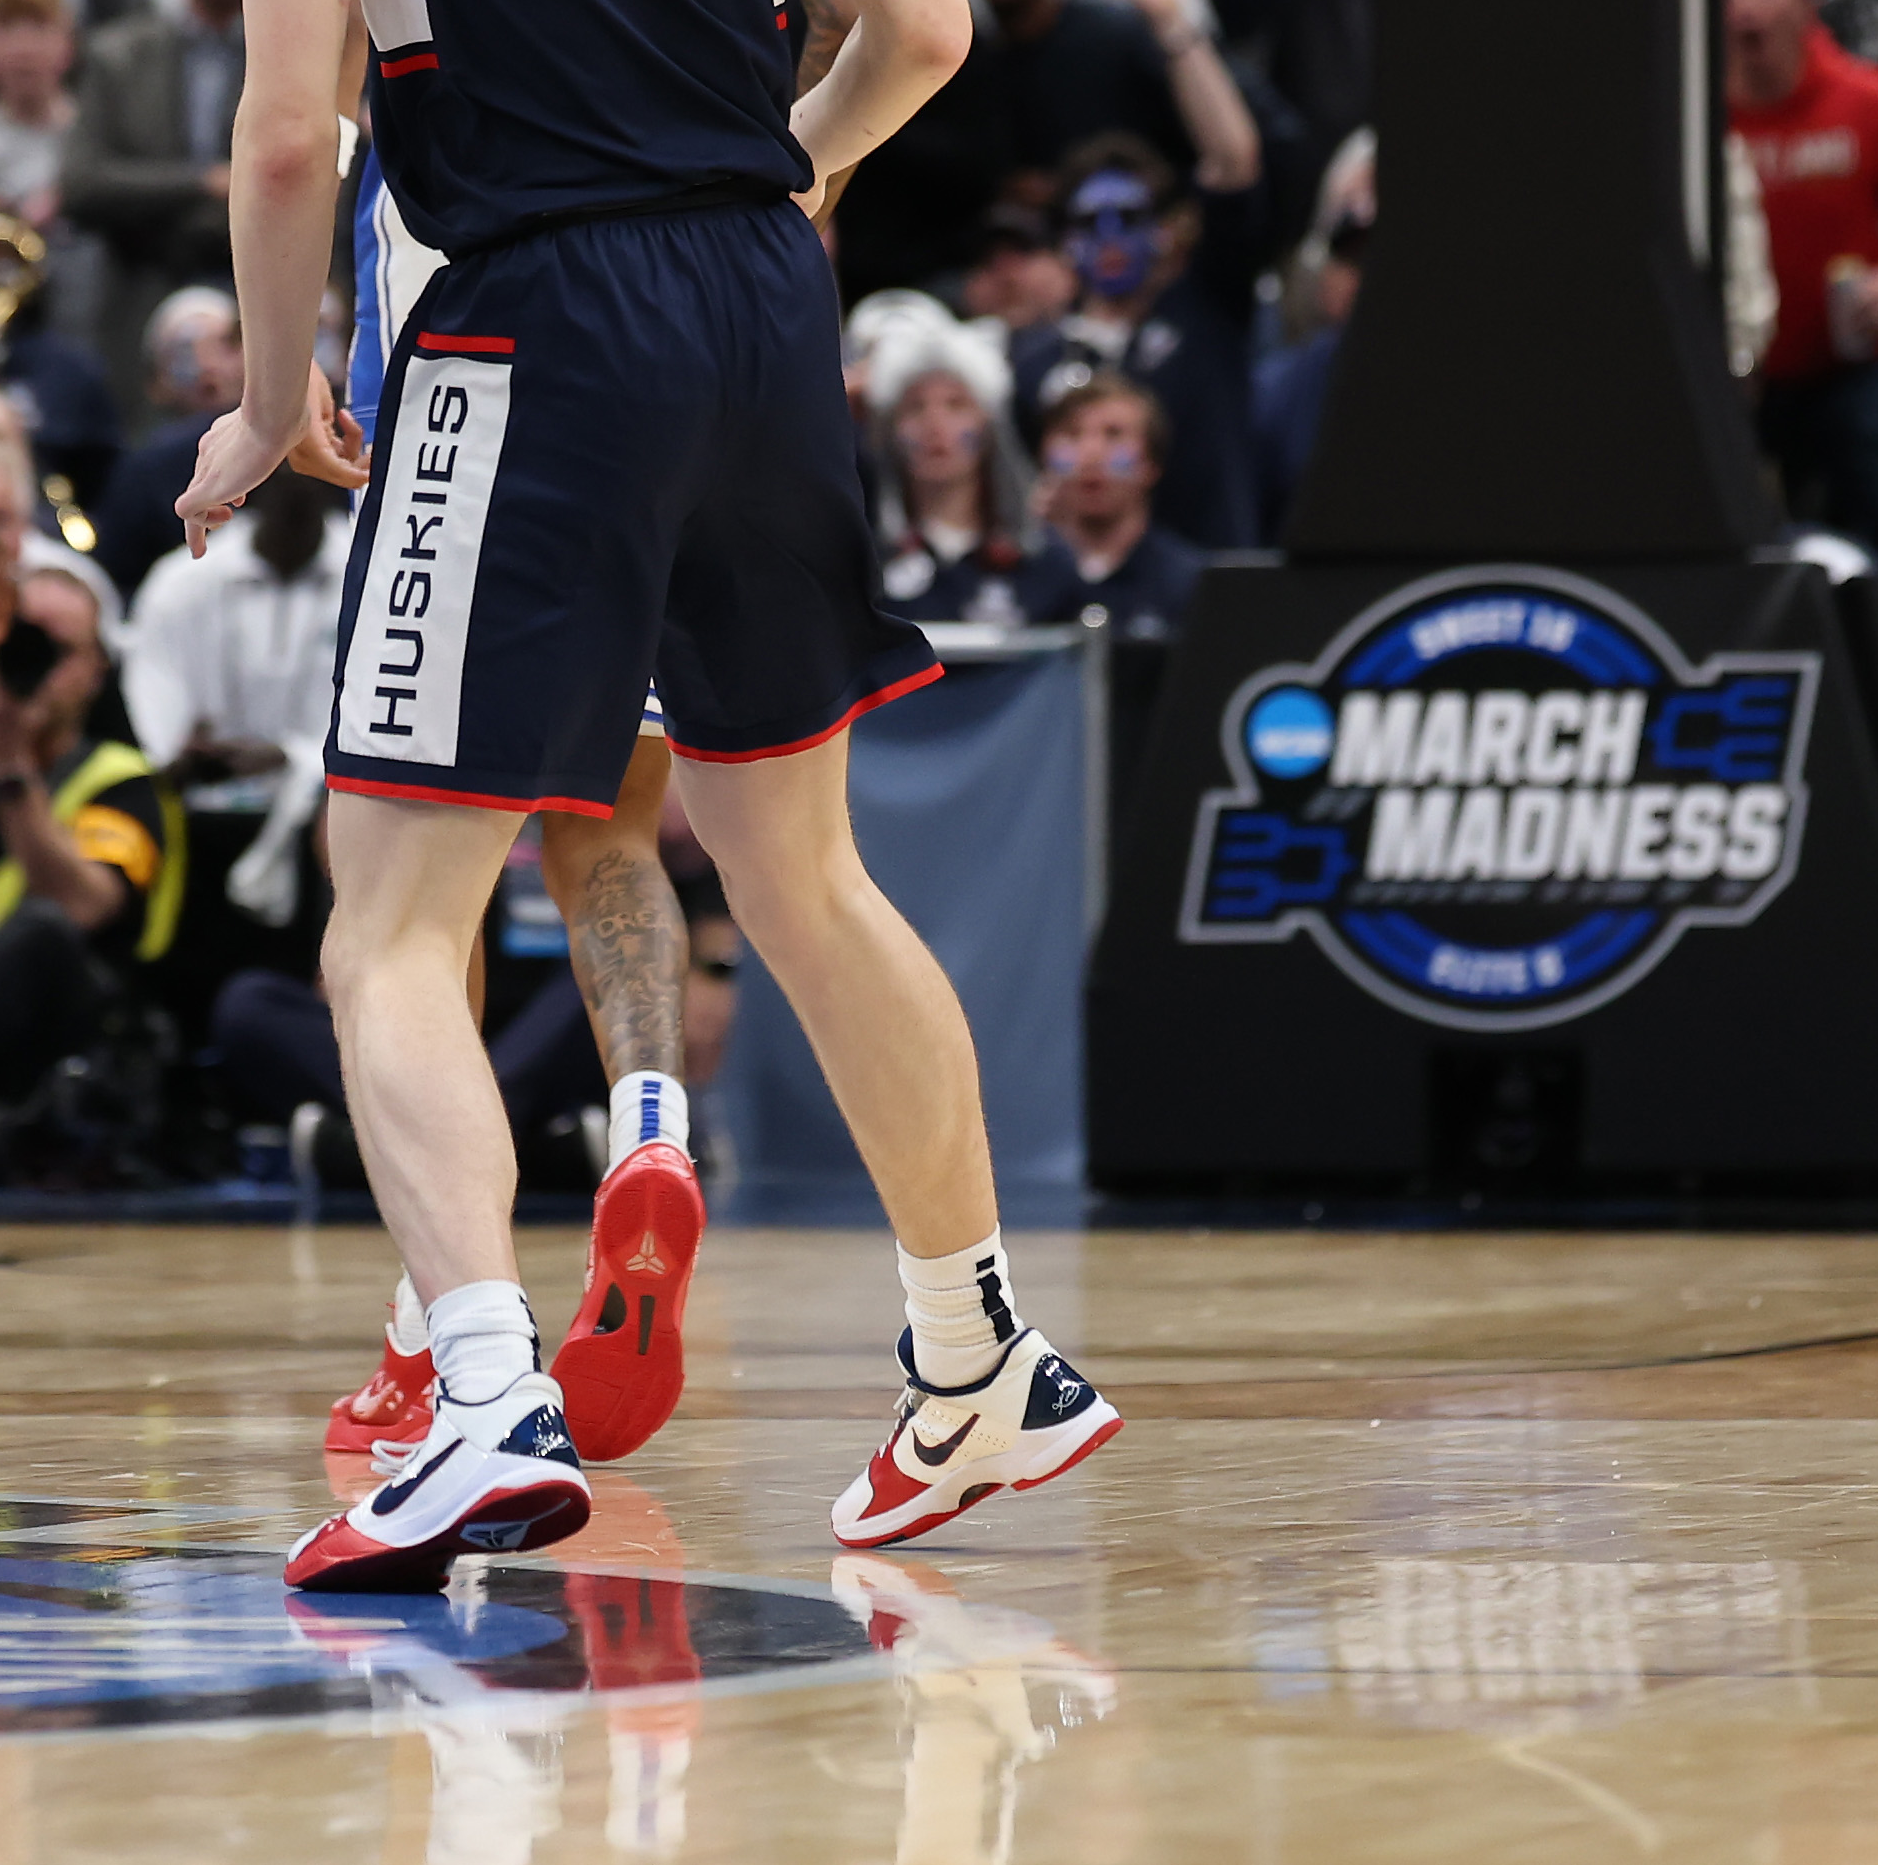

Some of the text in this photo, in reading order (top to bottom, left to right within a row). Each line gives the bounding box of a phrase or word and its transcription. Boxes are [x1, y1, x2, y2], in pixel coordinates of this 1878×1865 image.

[368, 384, 471, 739] HUSKIES
[1326, 686, 1651, 788] MARCH
[1362, 783, 1792, 884] MADNESS
